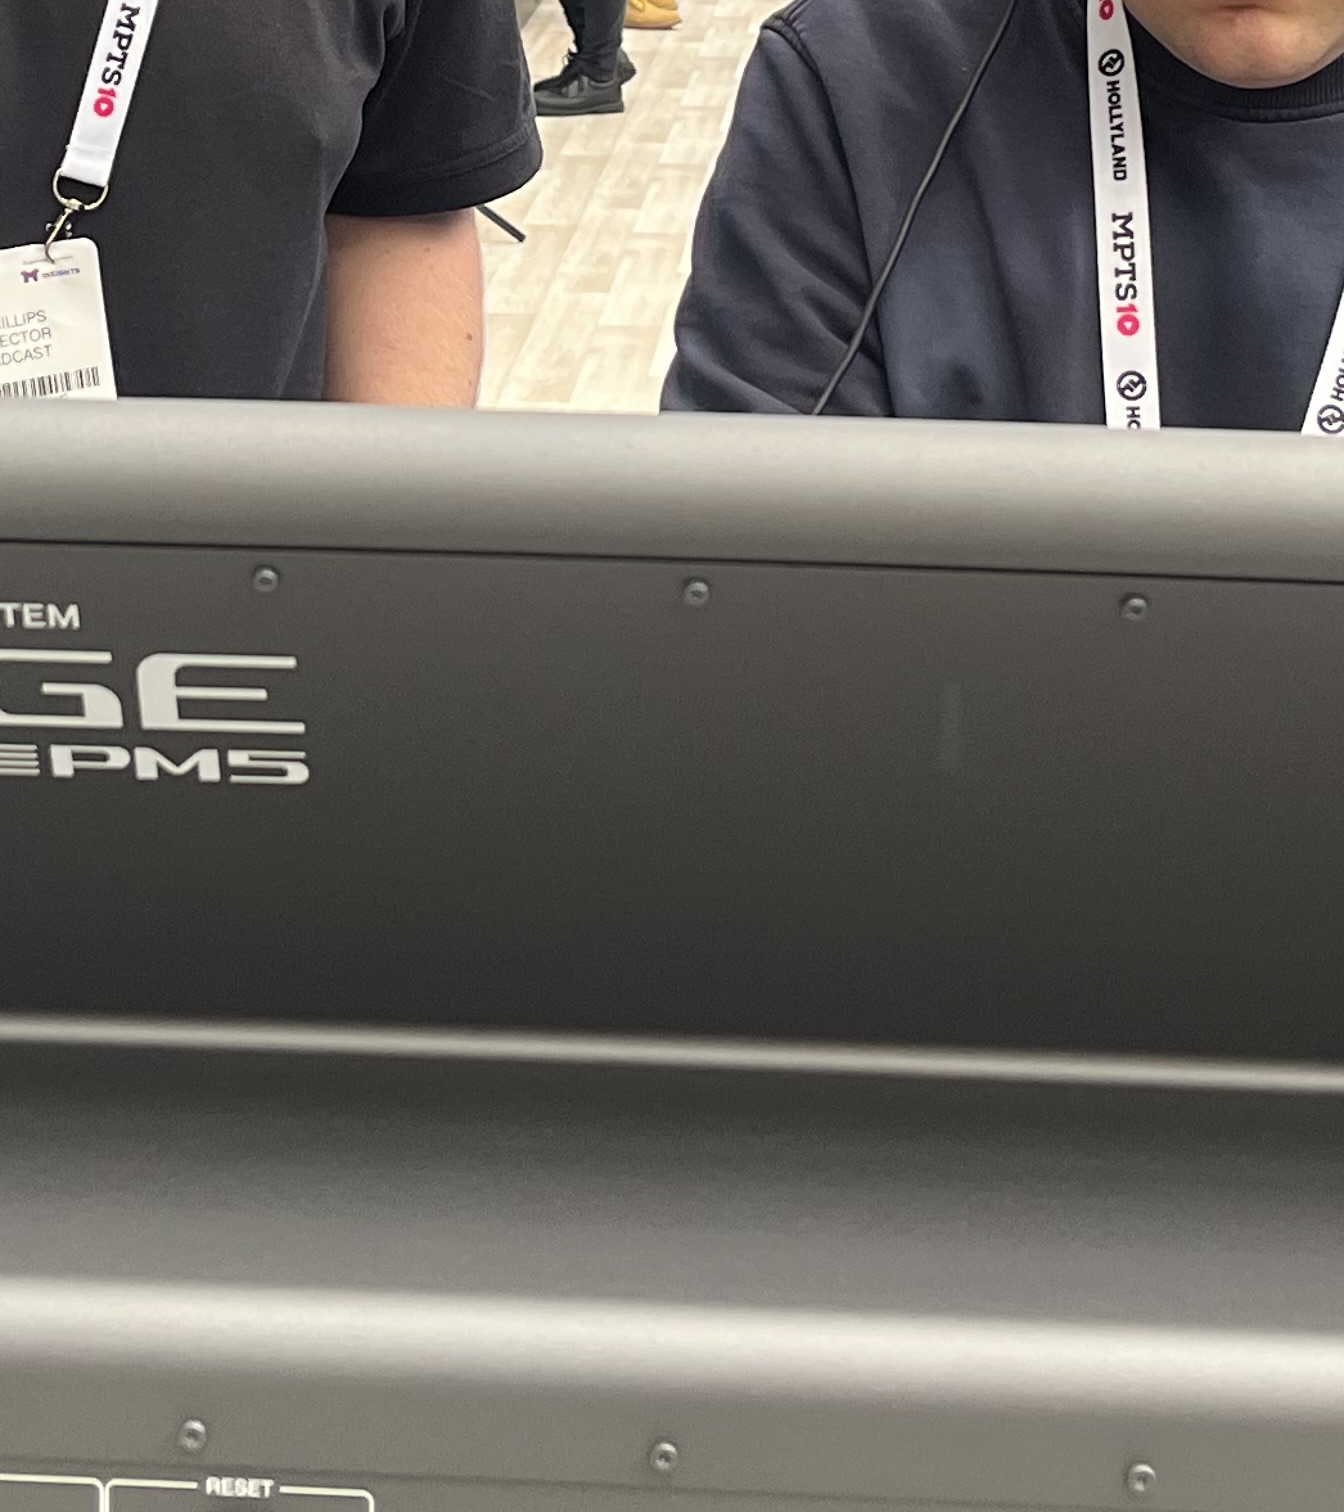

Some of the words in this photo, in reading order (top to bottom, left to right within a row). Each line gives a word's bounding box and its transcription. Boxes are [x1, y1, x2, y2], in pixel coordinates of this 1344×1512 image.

[1106, 79, 1128, 182] HOLLYLAND
[50, 741, 311, 785] PM5
[205, 1476, 275, 1498] RESET
